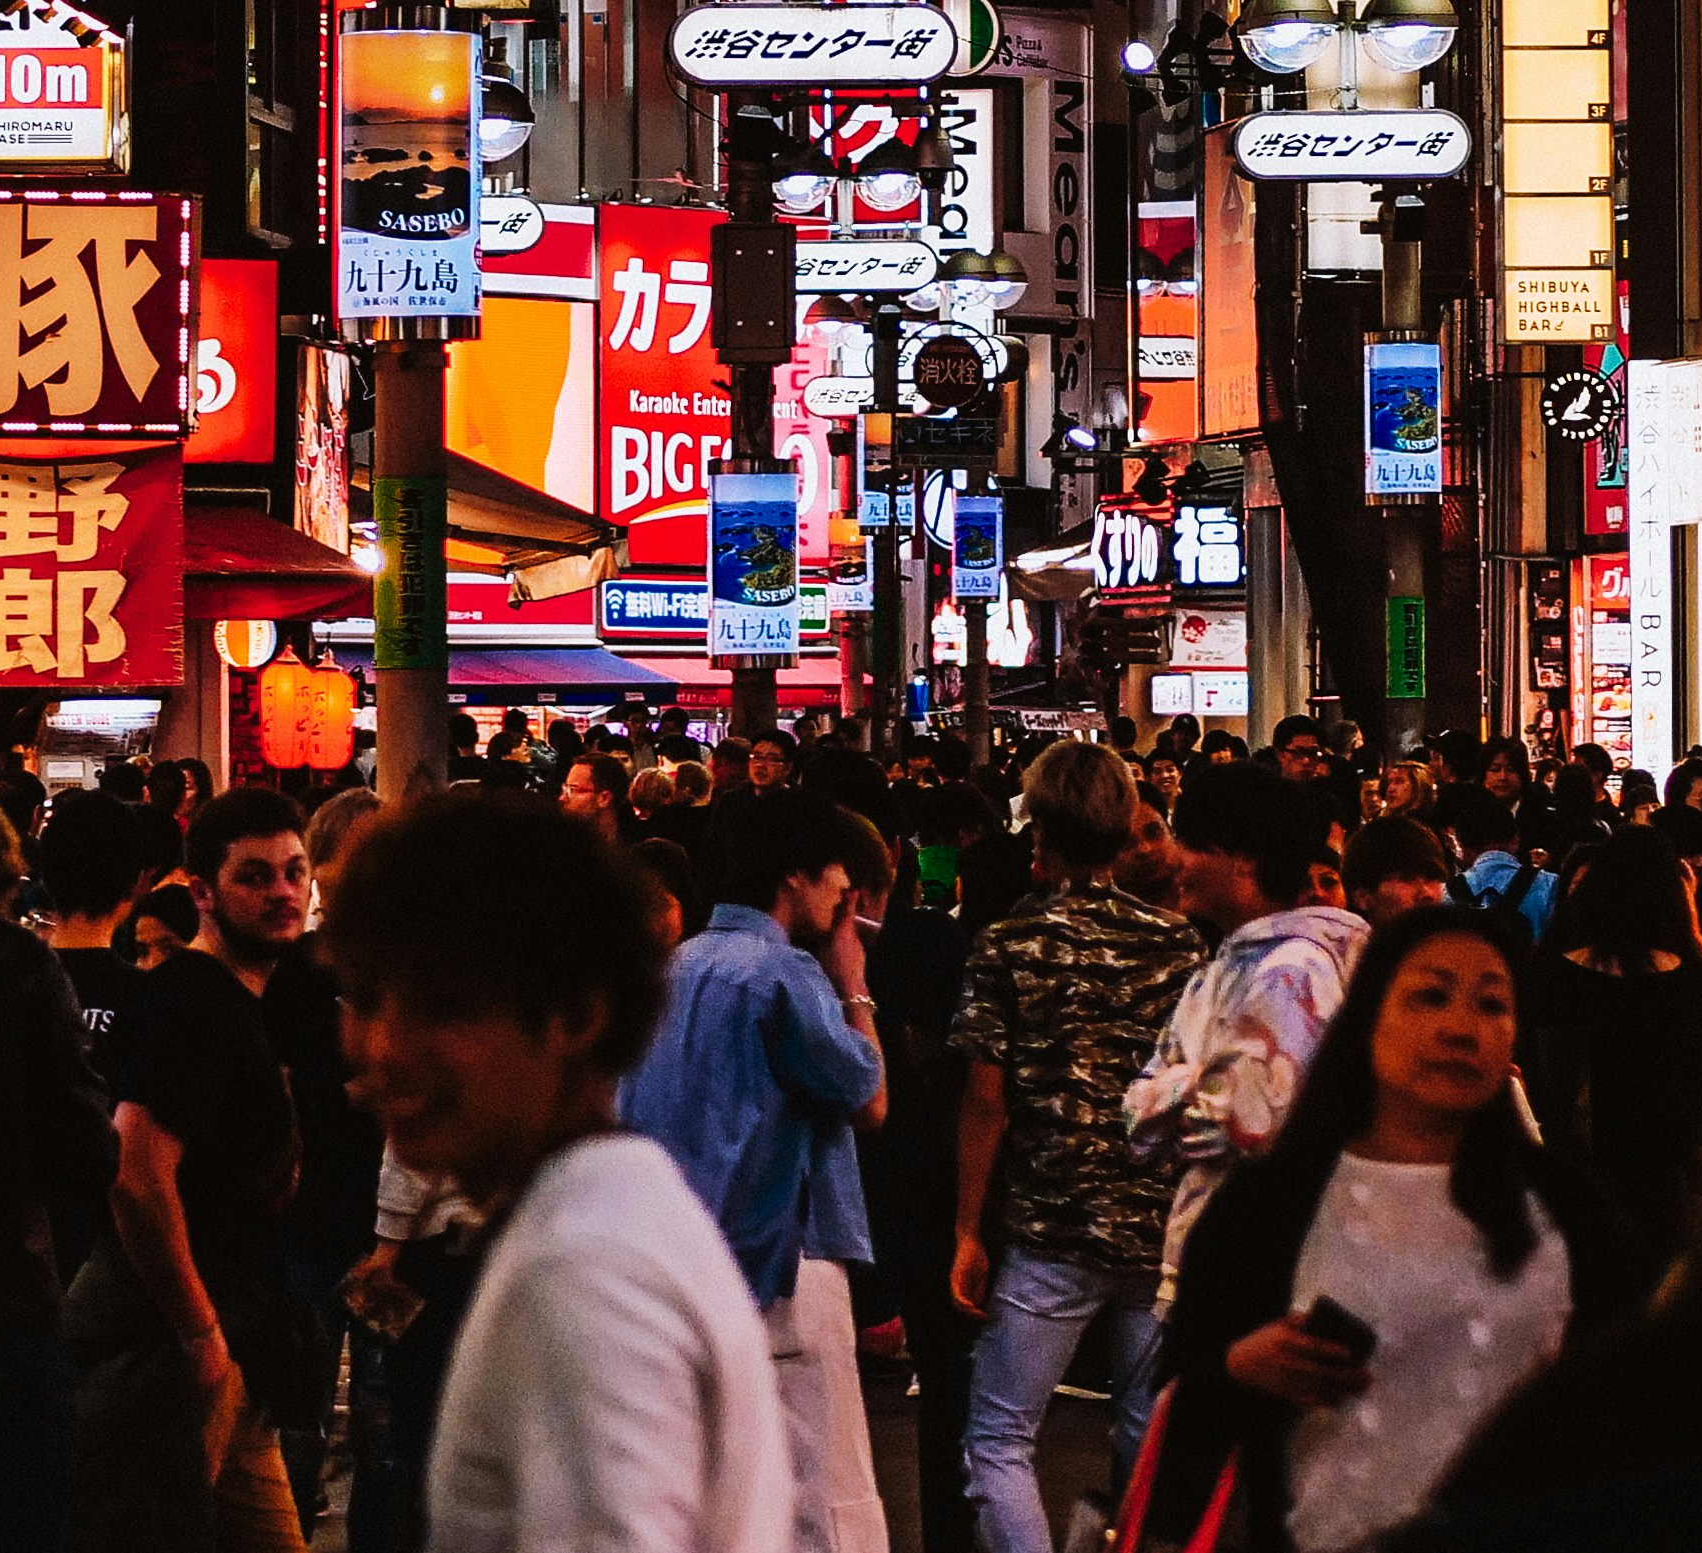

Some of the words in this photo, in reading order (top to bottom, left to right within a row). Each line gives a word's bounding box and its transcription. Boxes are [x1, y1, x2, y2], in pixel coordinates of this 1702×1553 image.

[685, 27, 937, 62] 渋谷センター街
[1590, 32, 1607, 46] 4F
[1591, 105, 1607, 118] 3F
[1249, 130, 1454, 160] 渋谷センター街
[1591, 178, 1608, 193] 2F
[378, 207, 466, 233] SASEBO
[1592, 251, 1609, 266] 1F
[346, 258, 459, 295] 九十九島
[1518, 281, 1591, 295] SHIBUYA
[1518, 301, 1602, 315] HIGHBALL
[1518, 318, 1551, 332] BAR
[919, 357, 979, 386] 消火栓
[629, 389, 689, 416] Karaoke
[611, 425, 694, 515] BIG
[1375, 464, 1436, 484] 九十九島
[1174, 506, 1241, 585] 福
[742, 584, 795, 603] SASEBO
[717, 617, 792, 642] 九十九島
[1640, 614, 1663, 688] BAR
